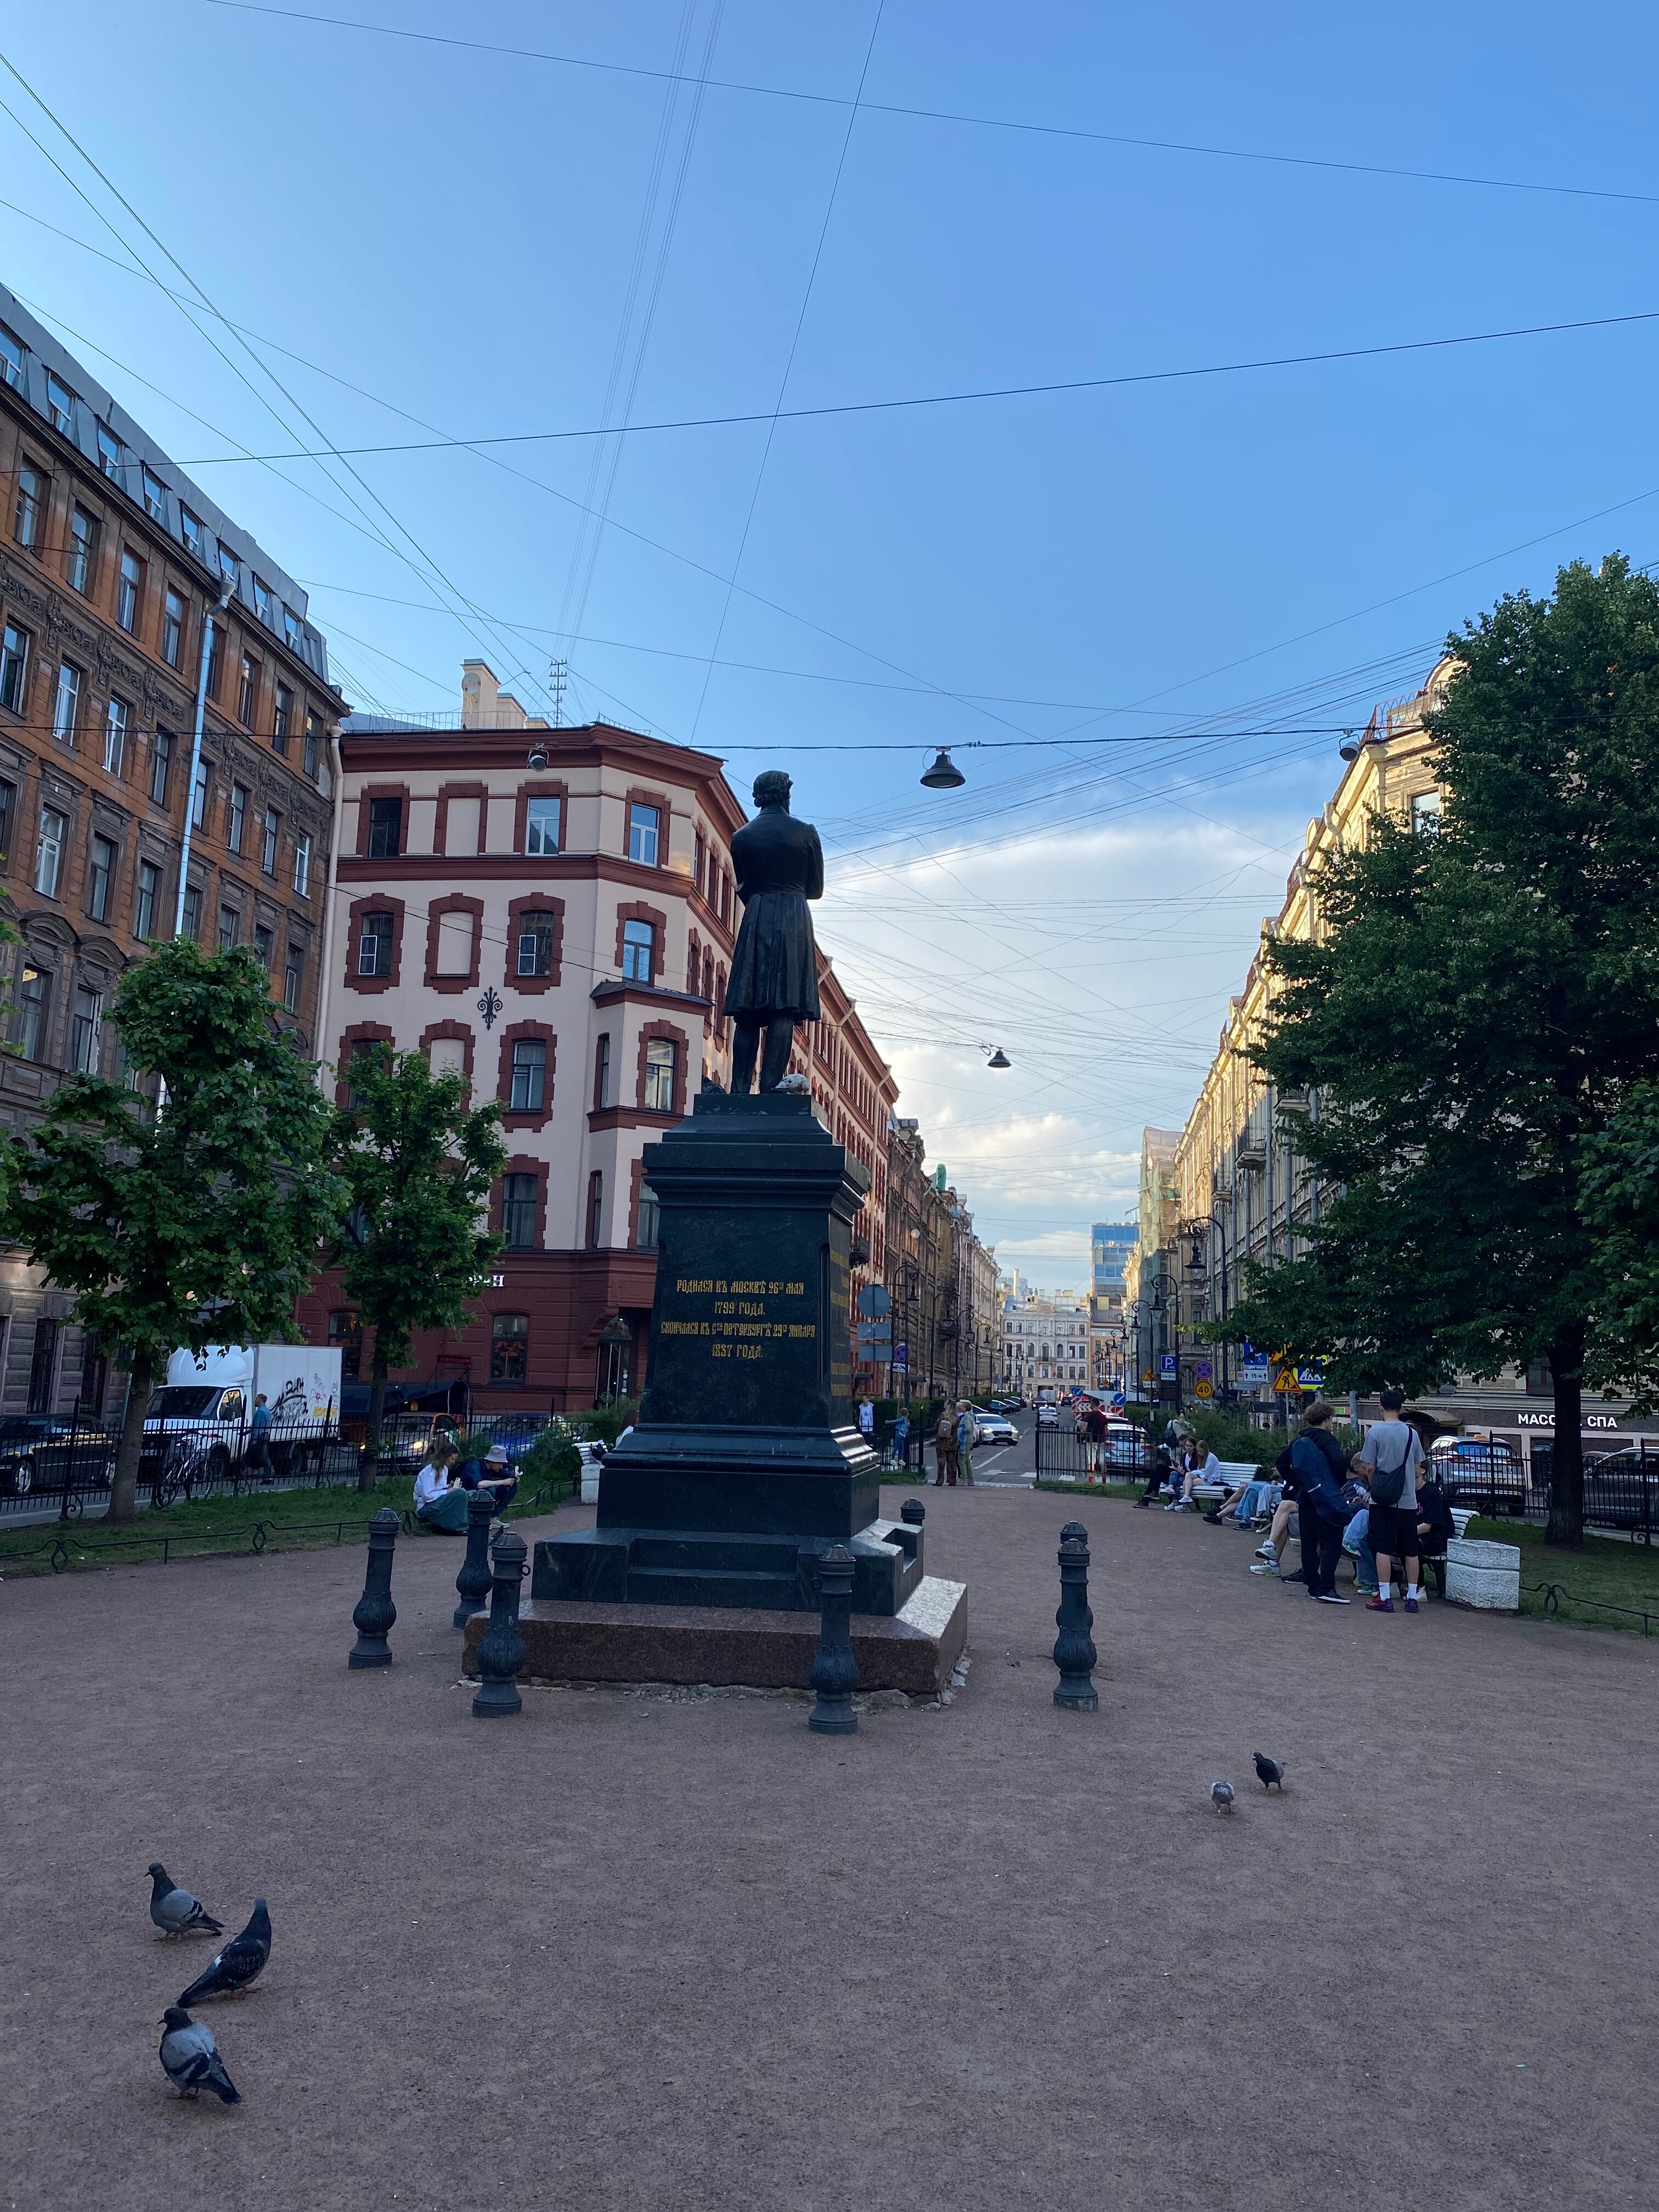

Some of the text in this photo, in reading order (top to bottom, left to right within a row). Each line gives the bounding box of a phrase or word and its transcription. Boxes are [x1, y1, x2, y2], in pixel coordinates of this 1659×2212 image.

[676, 1279, 713, 1294] РОДИЛСЯ
[716, 1280, 727, 1293] ВЪ
[786, 1282, 804, 1295] МАЯ
[714, 1301, 766, 1317] 1799 ГОДА.
[661, 1321, 699, 1335] СКОНЧАЛСЯ
[789, 1324, 816, 1338] ЯНВАРЯ
[712, 1344, 733, 1357] 1837
[1165, 1357, 1173, 1369] P
[1198, 1386, 1209, 1394] 40
[1587, 1415, 1618, 1428] СПА
